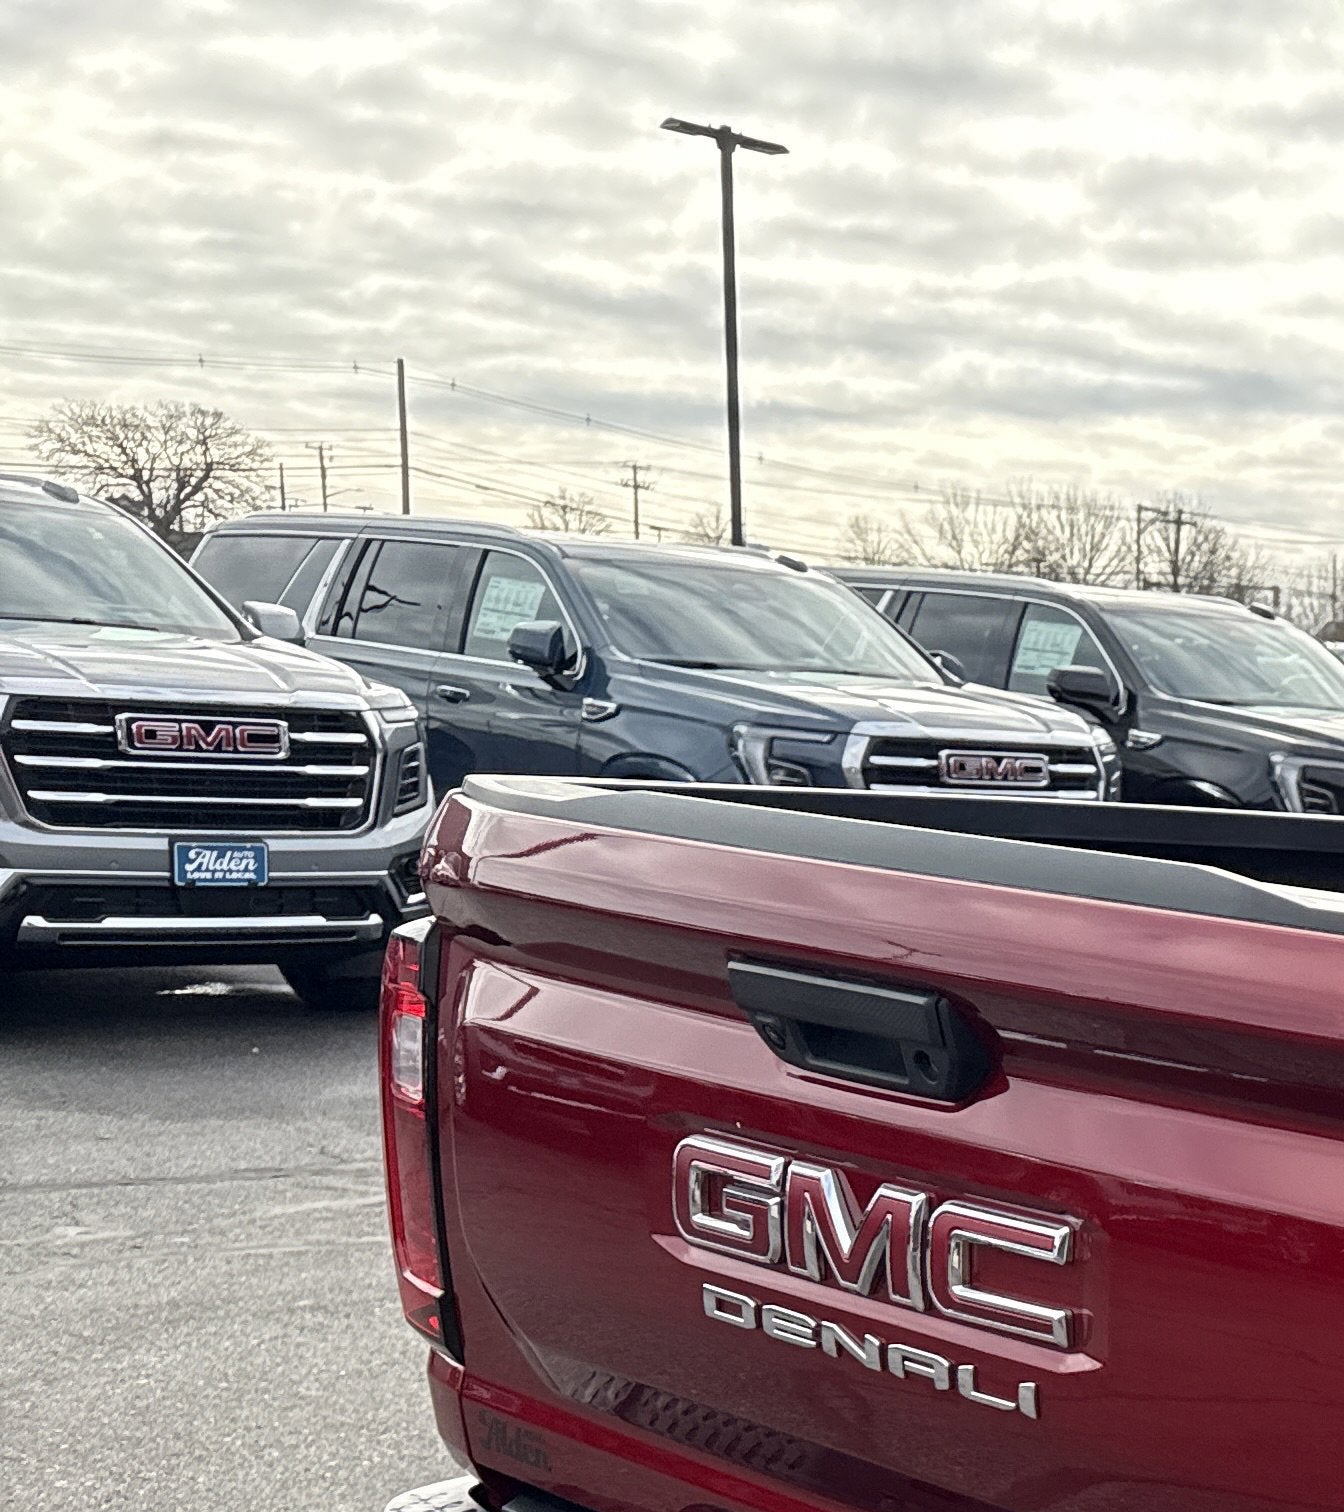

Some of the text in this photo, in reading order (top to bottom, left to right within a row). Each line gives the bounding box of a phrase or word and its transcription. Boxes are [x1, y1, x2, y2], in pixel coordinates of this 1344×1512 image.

[132, 721, 281, 752] GMC
[949, 756, 1046, 781] GMC
[185, 848, 258, 871] Alden
[671, 1133, 1077, 1348] GMC
[702, 1281, 1038, 1420] DENALI
